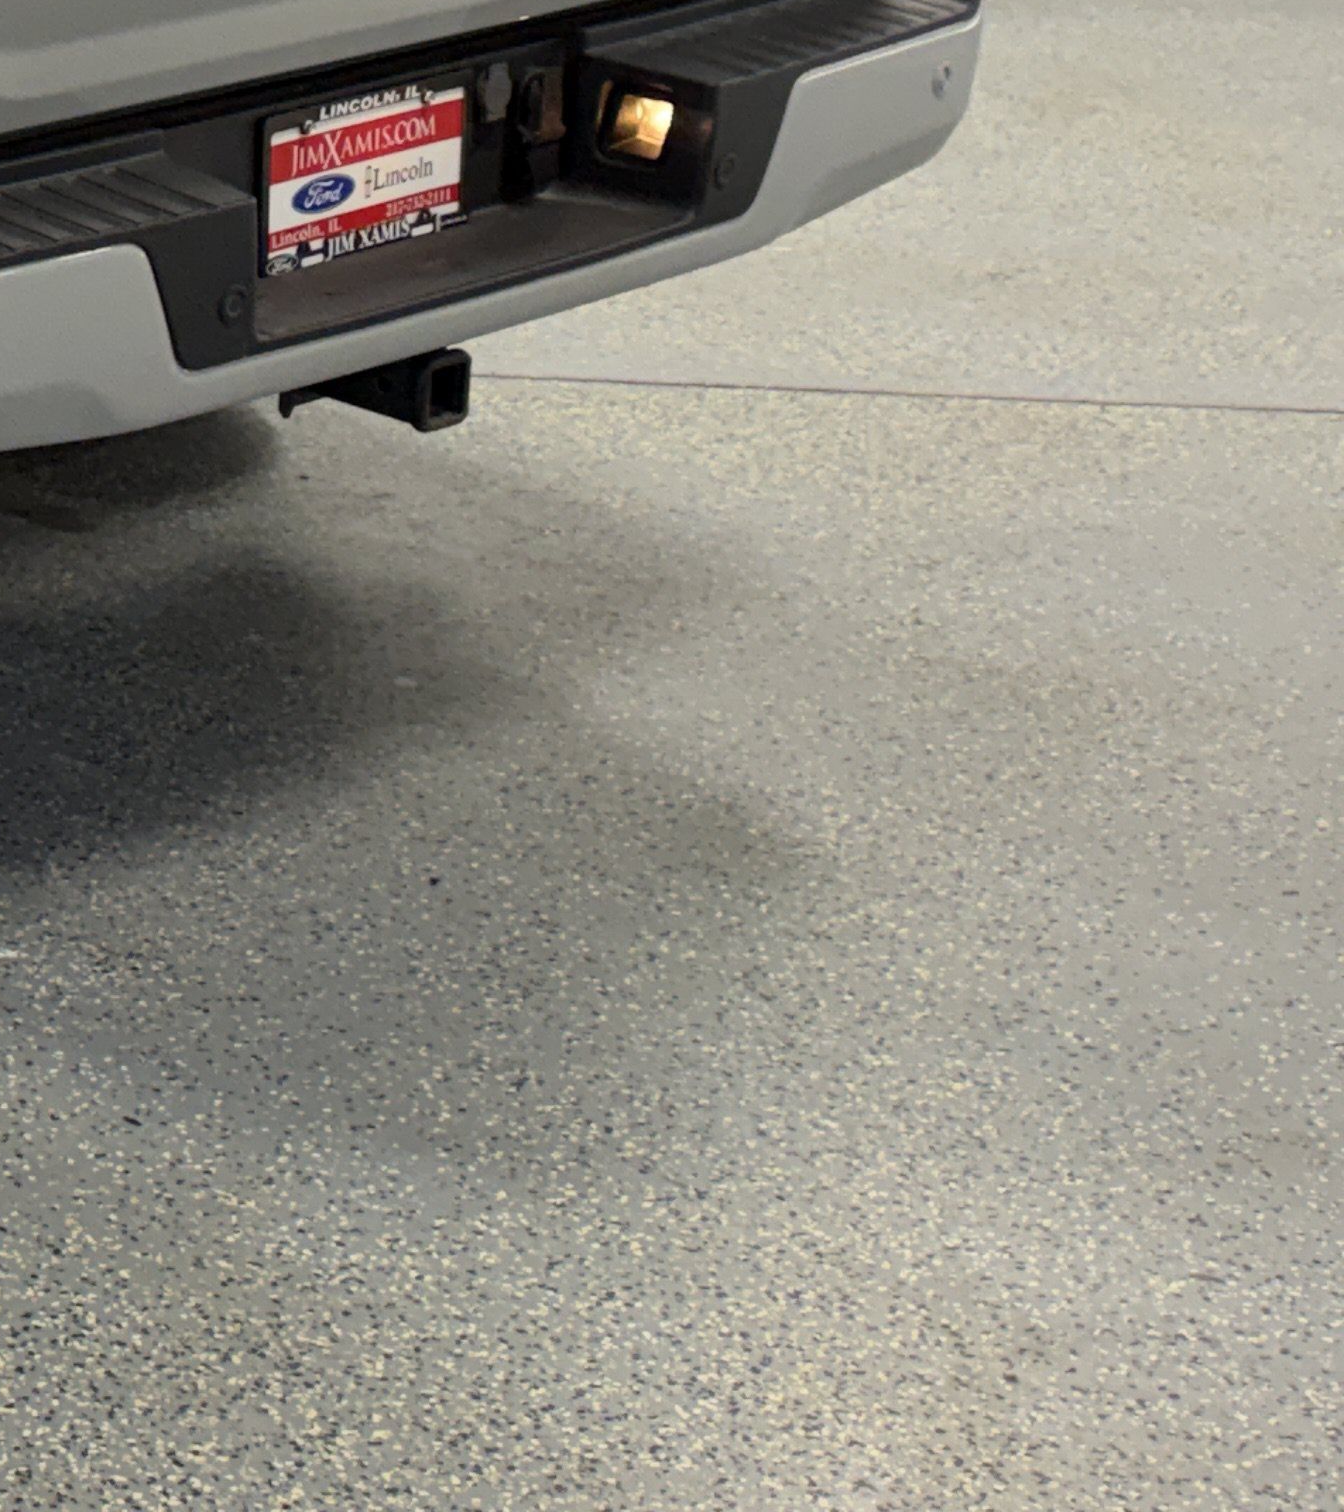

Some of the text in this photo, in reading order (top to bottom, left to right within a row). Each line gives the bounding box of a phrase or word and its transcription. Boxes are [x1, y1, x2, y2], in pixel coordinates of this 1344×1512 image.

[374, 157, 434, 192] Lincoln
[304, 178, 343, 208] Ford
[326, 231, 357, 263] JIM
[357, 219, 411, 248] XAMIS
